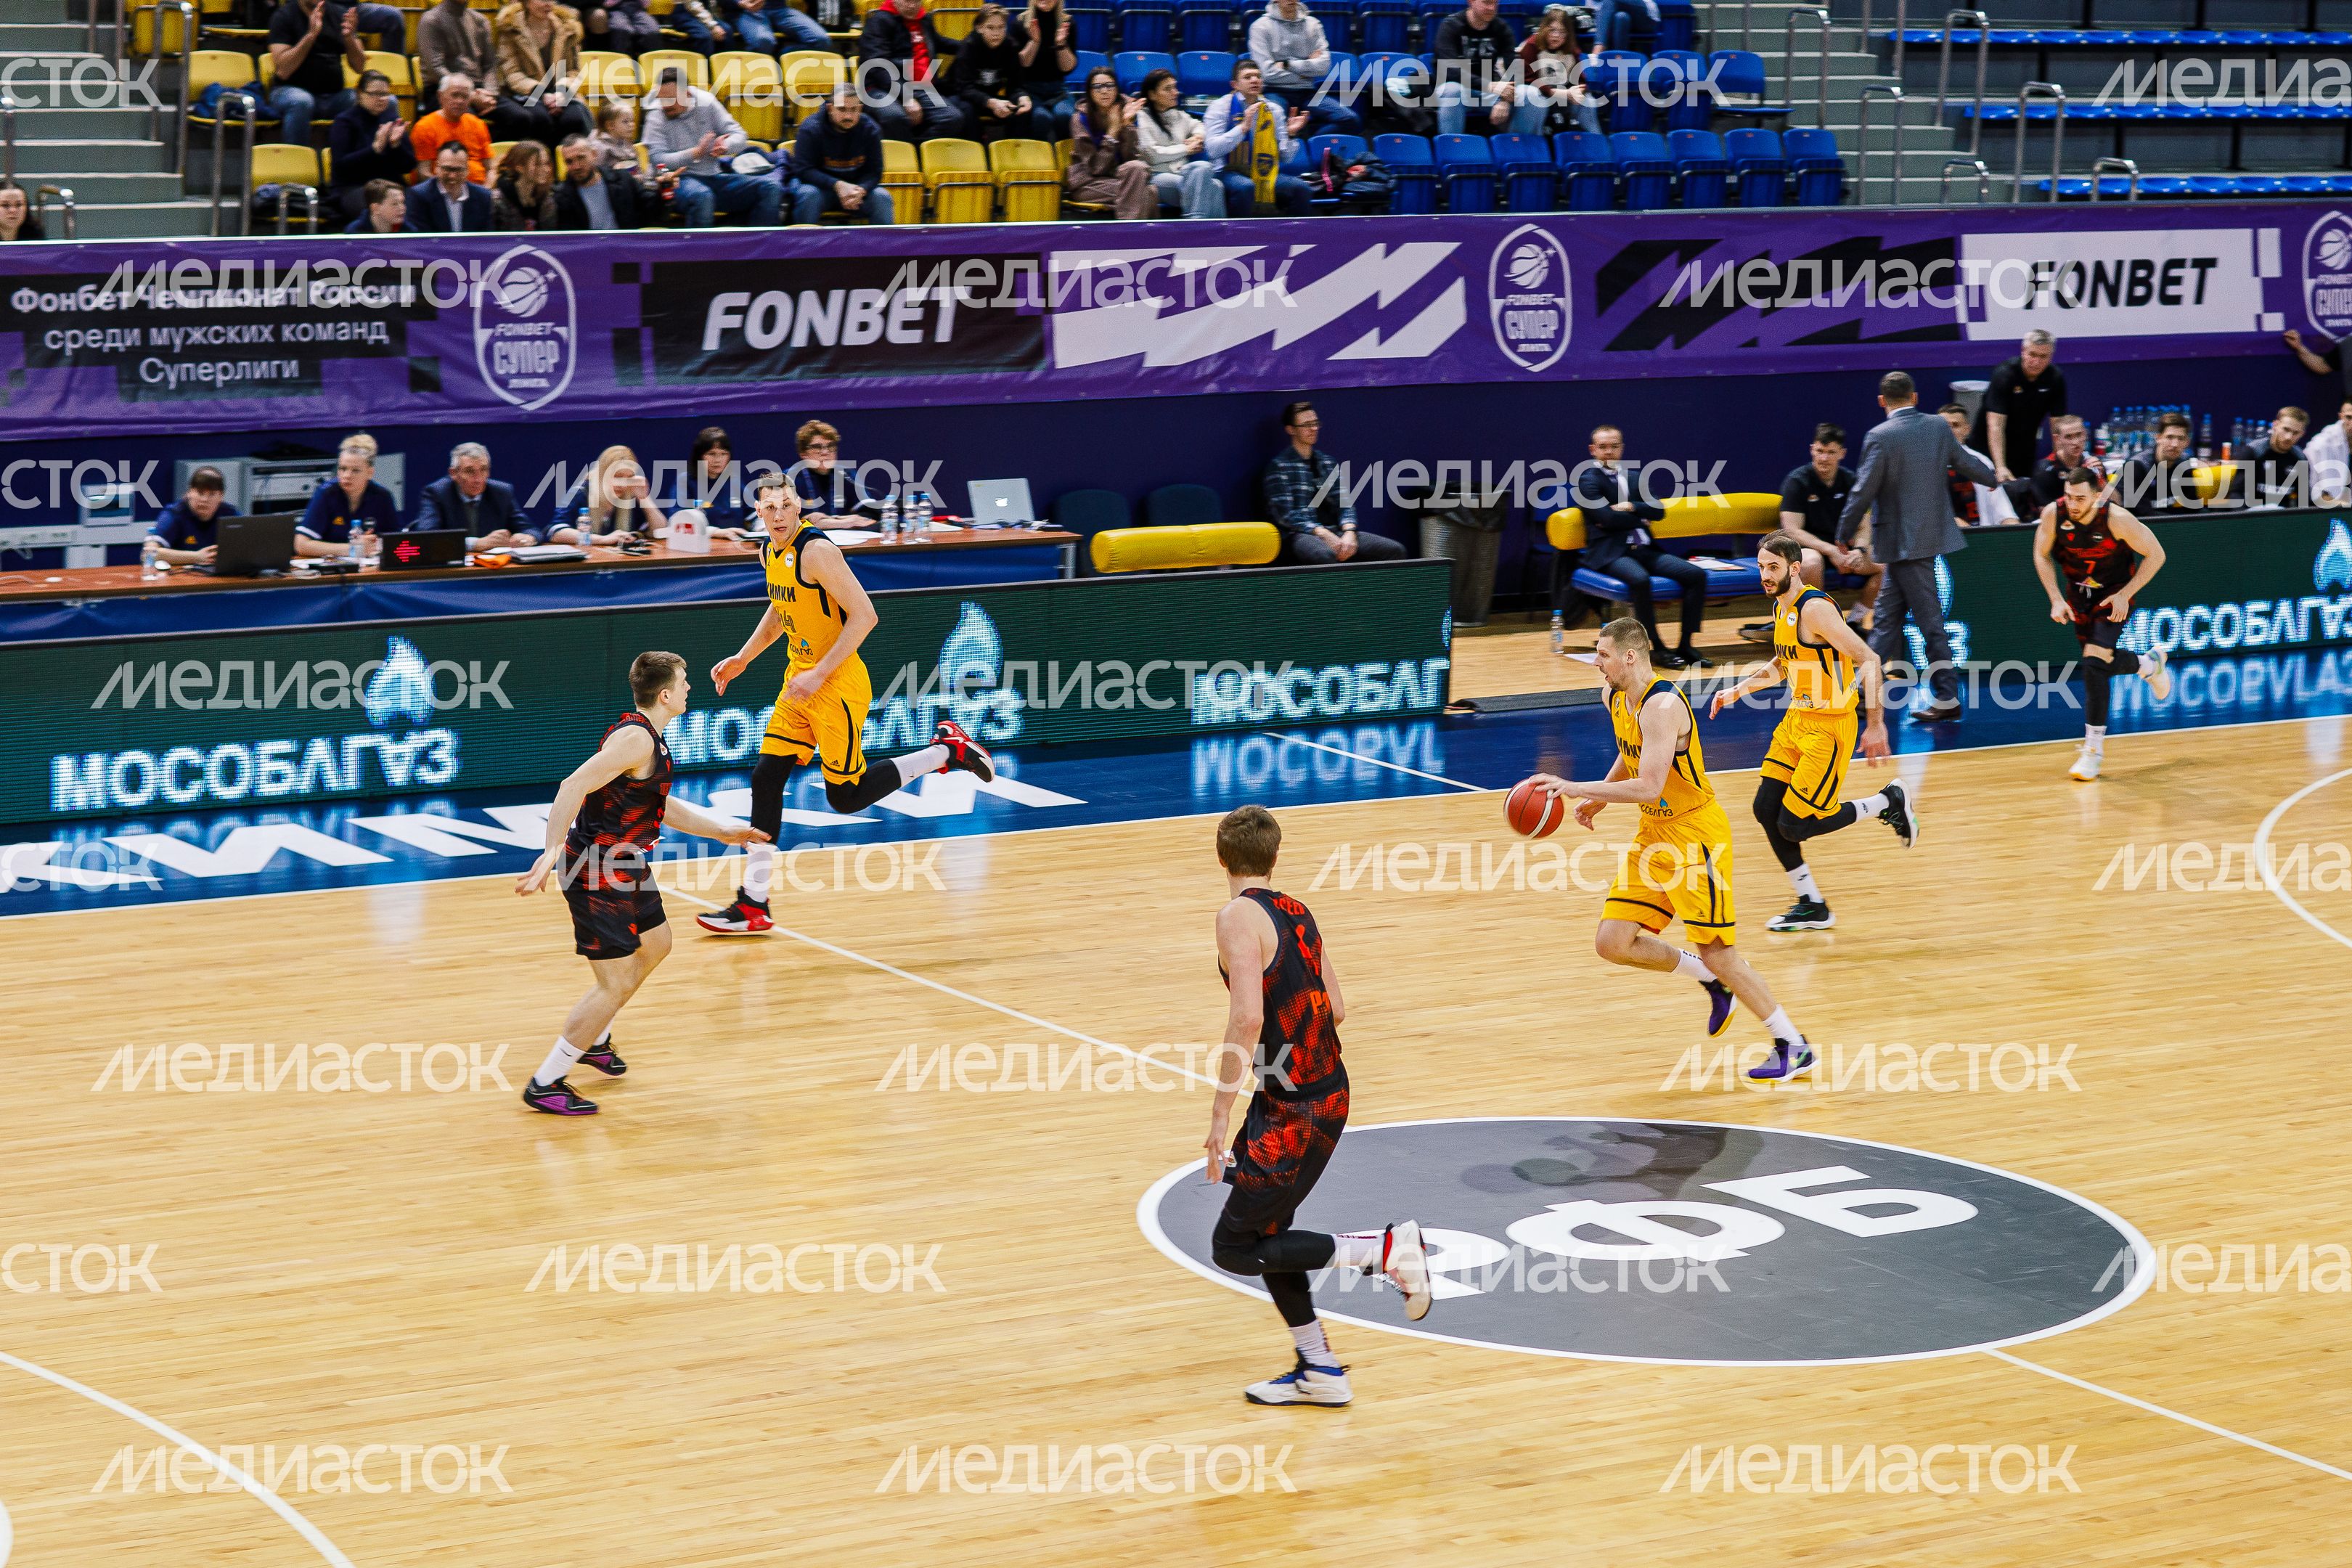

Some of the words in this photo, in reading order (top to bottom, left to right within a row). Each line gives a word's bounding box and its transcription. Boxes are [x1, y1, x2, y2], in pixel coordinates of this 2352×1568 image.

[10, 284, 131, 313] Фонбет
[2022, 257, 2218, 310] FONBET
[702, 286, 973, 351] FONBET
[44, 326, 141, 356] среди
[150, 323, 274, 353] мужских
[282, 320, 390, 346] команд
[139, 356, 300, 389] Суперлиги
[2083, 560, 2096, 574] 7
